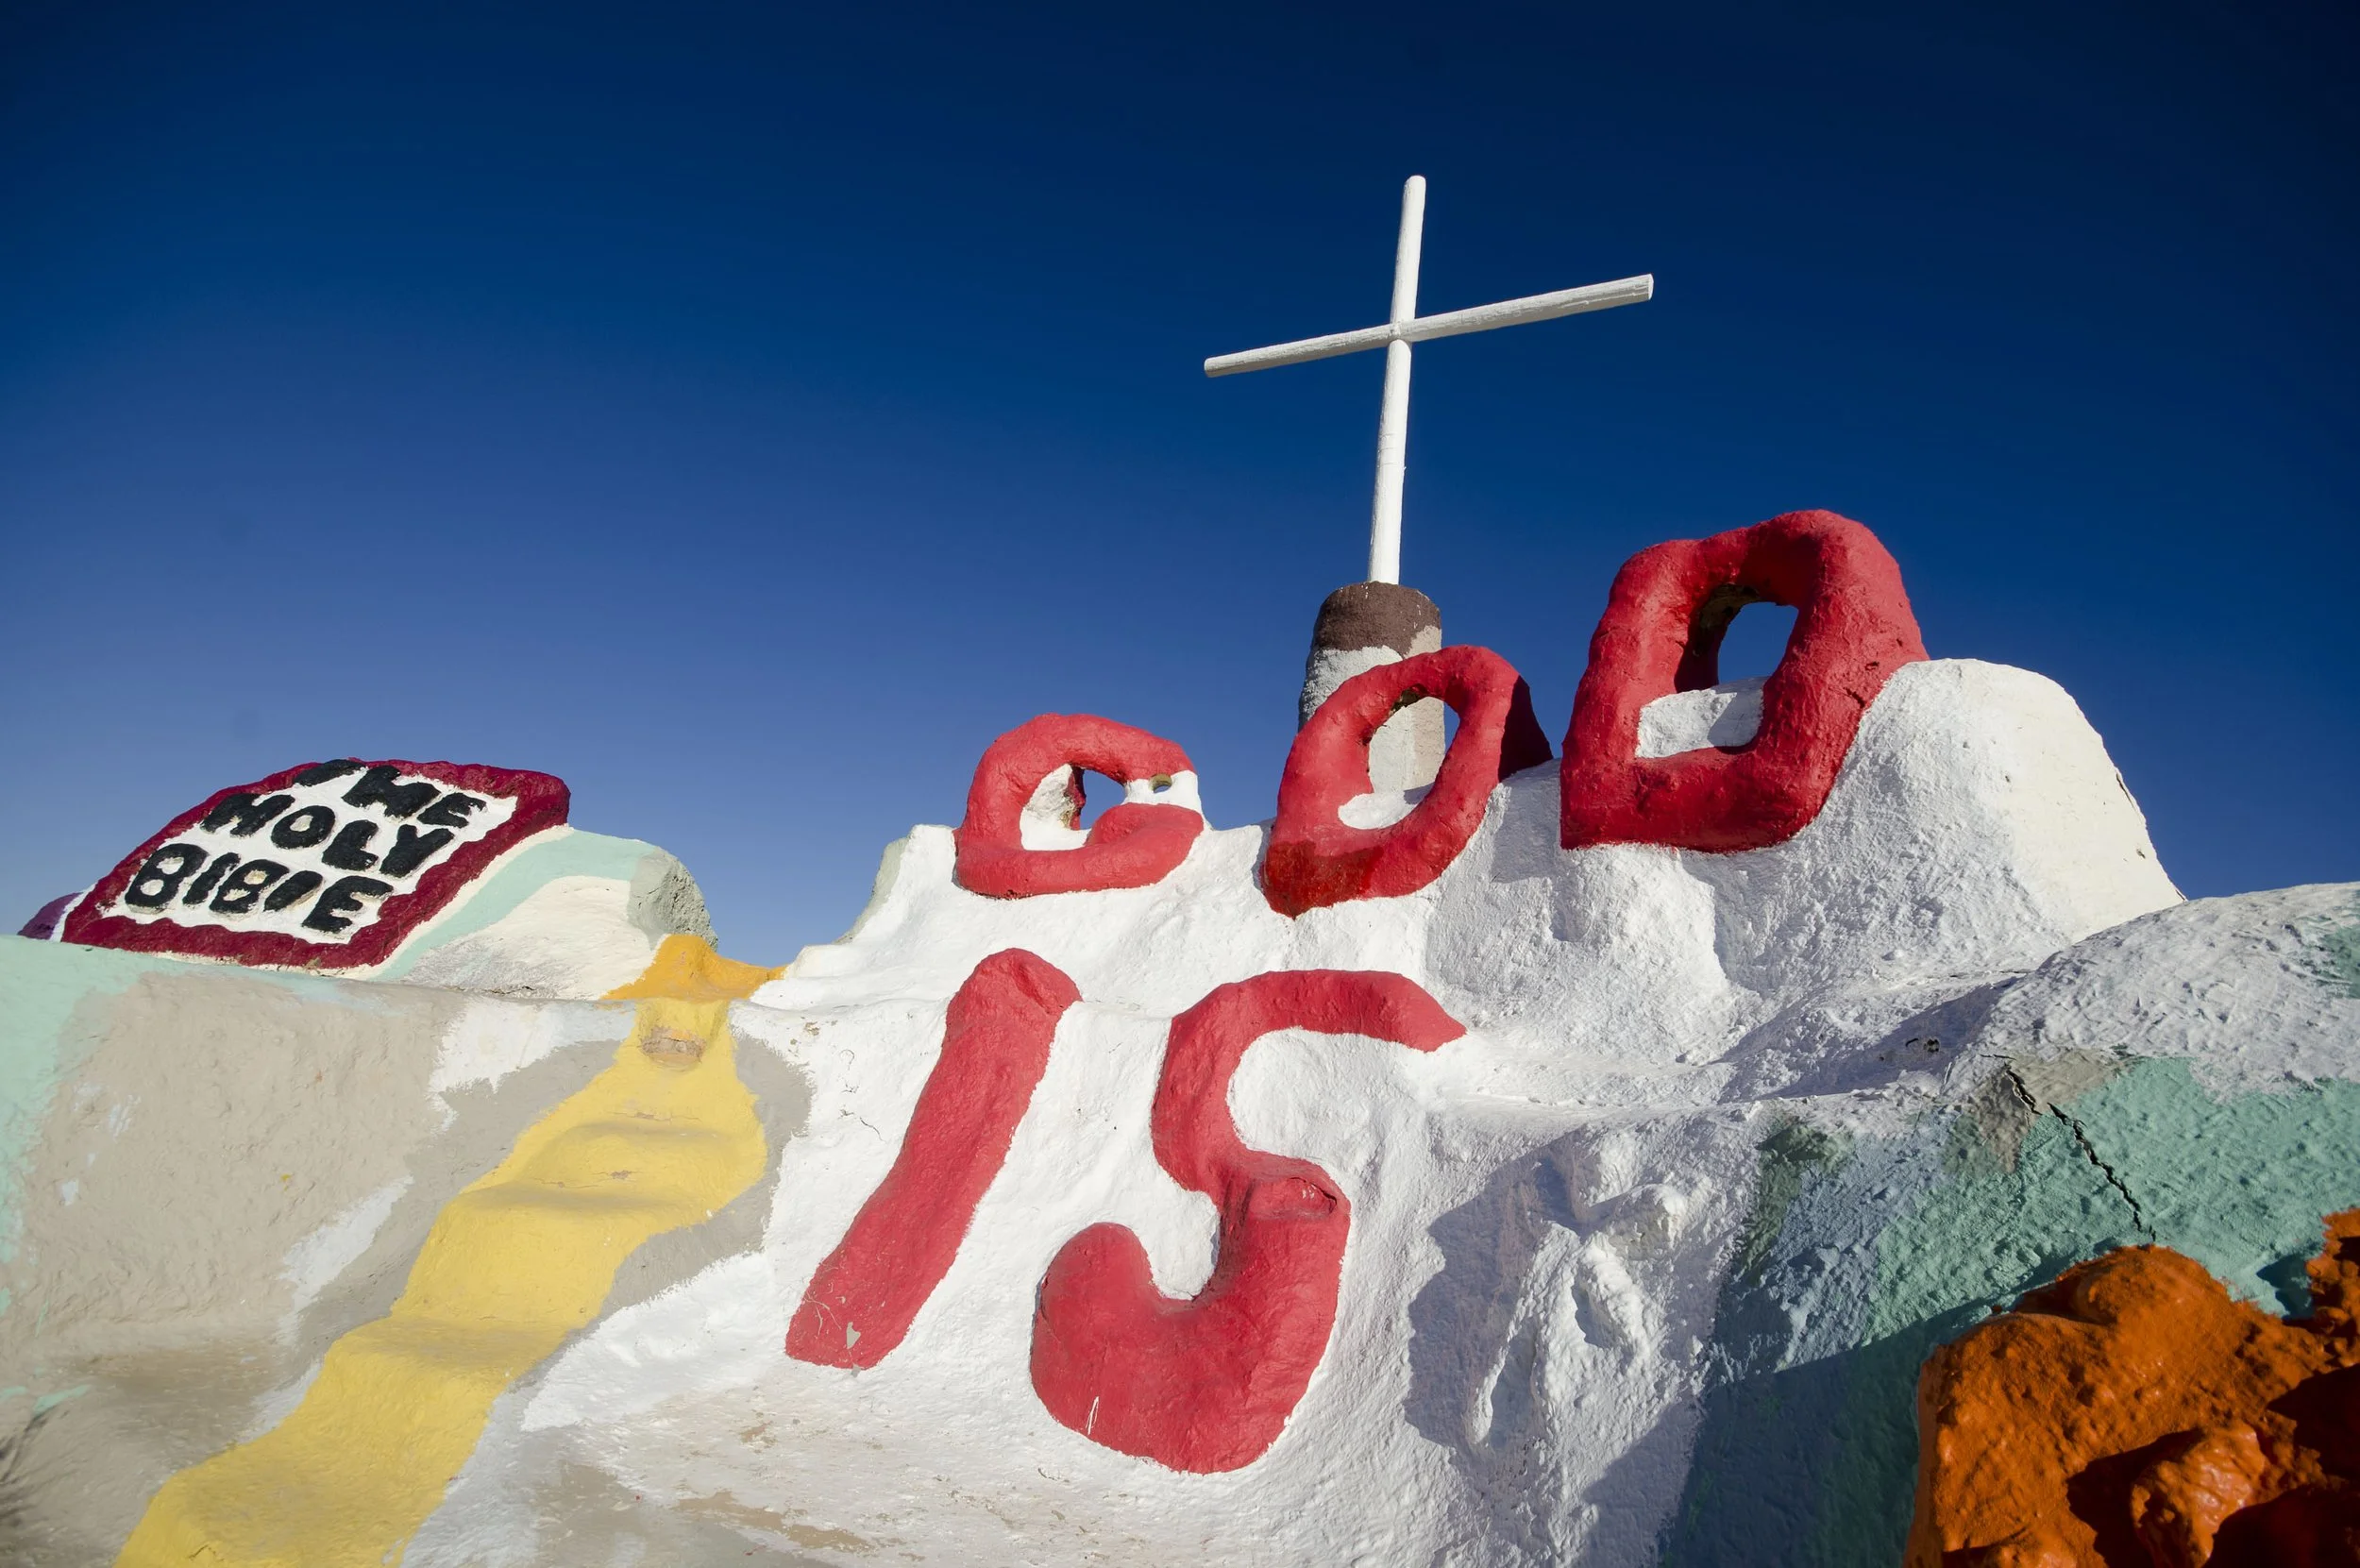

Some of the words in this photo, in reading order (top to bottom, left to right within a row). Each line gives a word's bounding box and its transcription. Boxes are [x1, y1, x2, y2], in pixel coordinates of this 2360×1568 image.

[199, 792, 455, 878] HOLY
[952, 509, 1929, 918] GOD
[786, 947, 1464, 1475] IS
